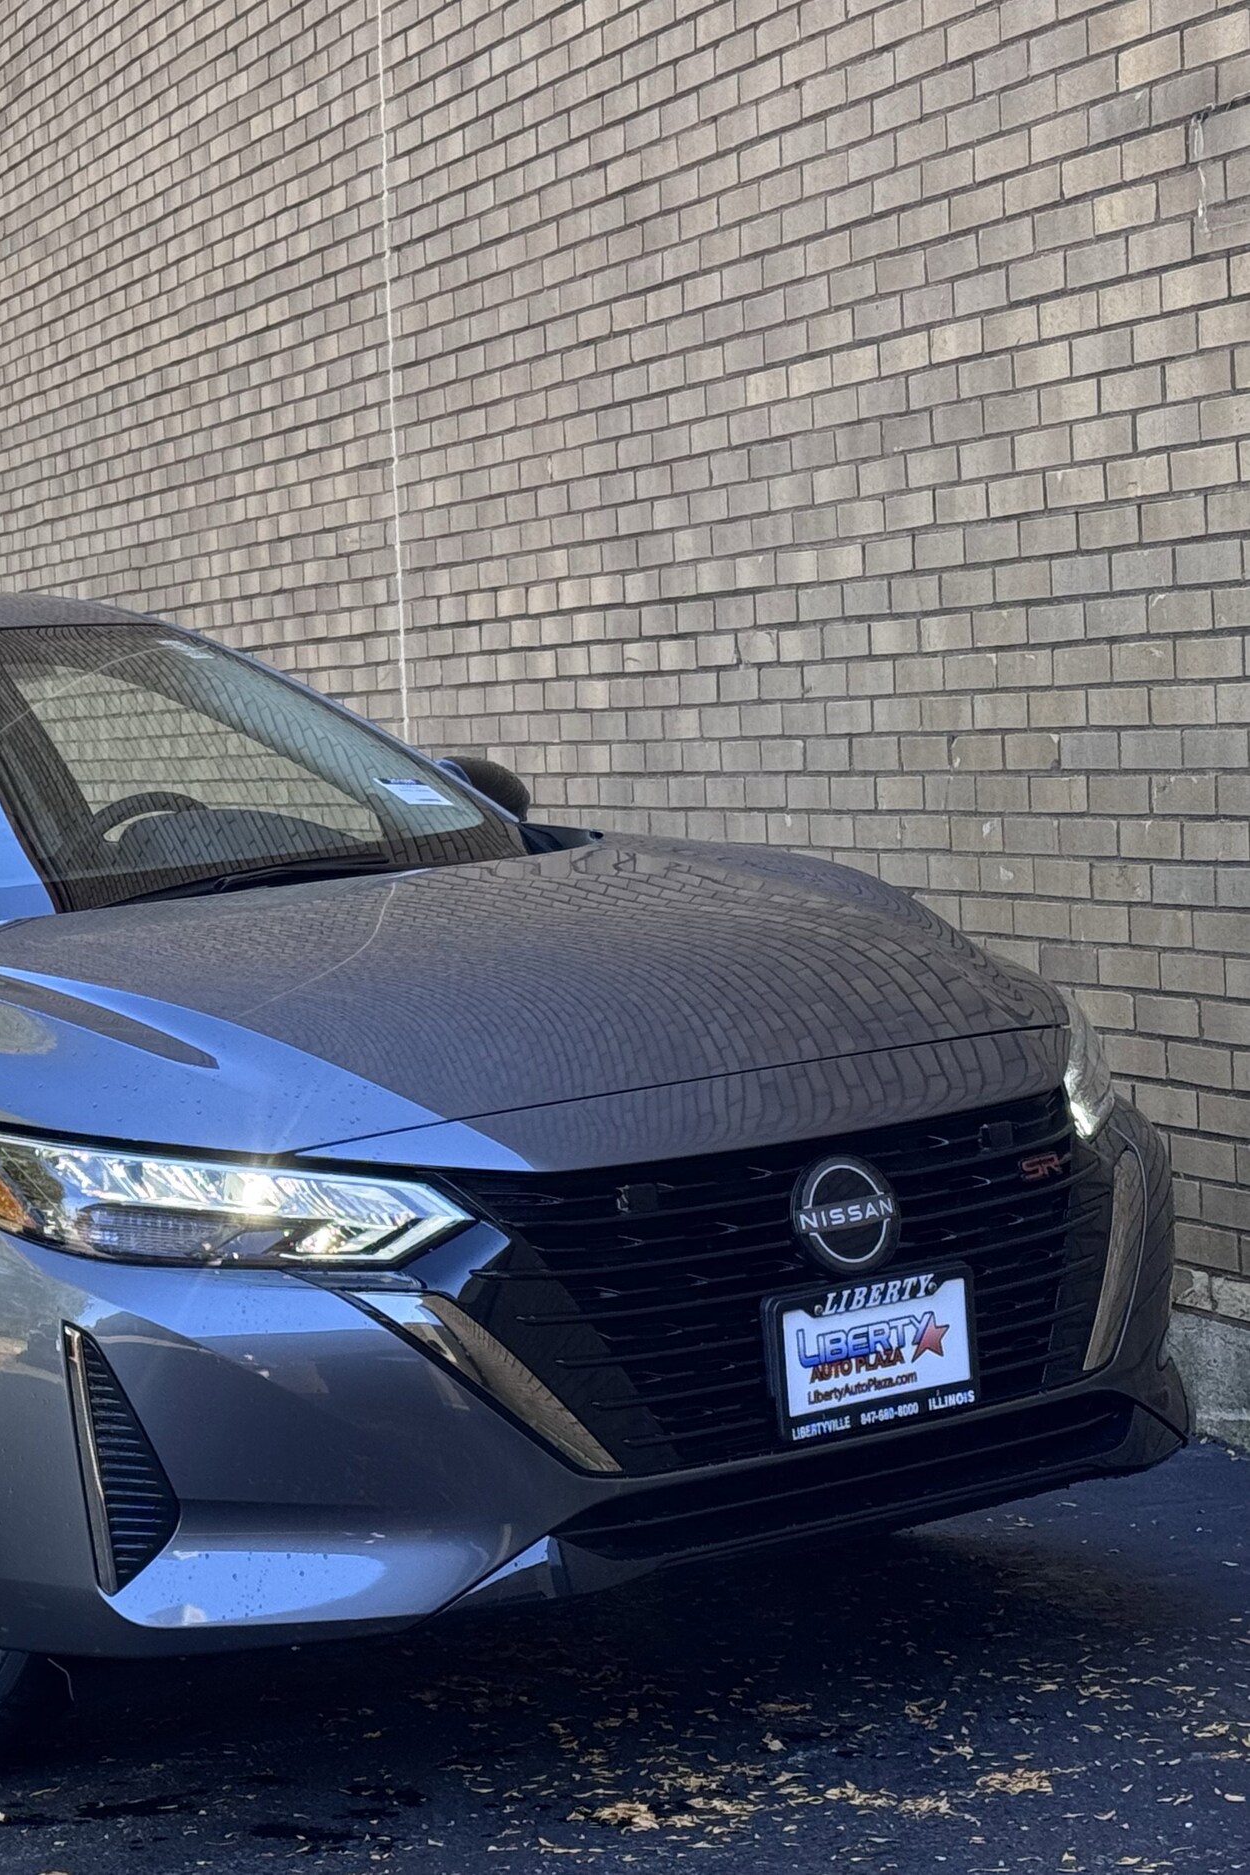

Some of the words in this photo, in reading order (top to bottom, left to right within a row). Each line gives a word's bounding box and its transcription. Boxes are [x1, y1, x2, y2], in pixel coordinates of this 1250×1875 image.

[1021, 1153, 1062, 1179] SR
[800, 1198, 893, 1230] NISSAN
[823, 1274, 934, 1316] LIBERTY
[810, 1361, 853, 1384] AUTO
[855, 1348, 905, 1374] PLAZA
[807, 1371, 917, 1406] LibertyAutoPlaza.com
[792, 1415, 850, 1441] LIBERTYVILLE
[928, 1390, 975, 1411] ILLINOIS
